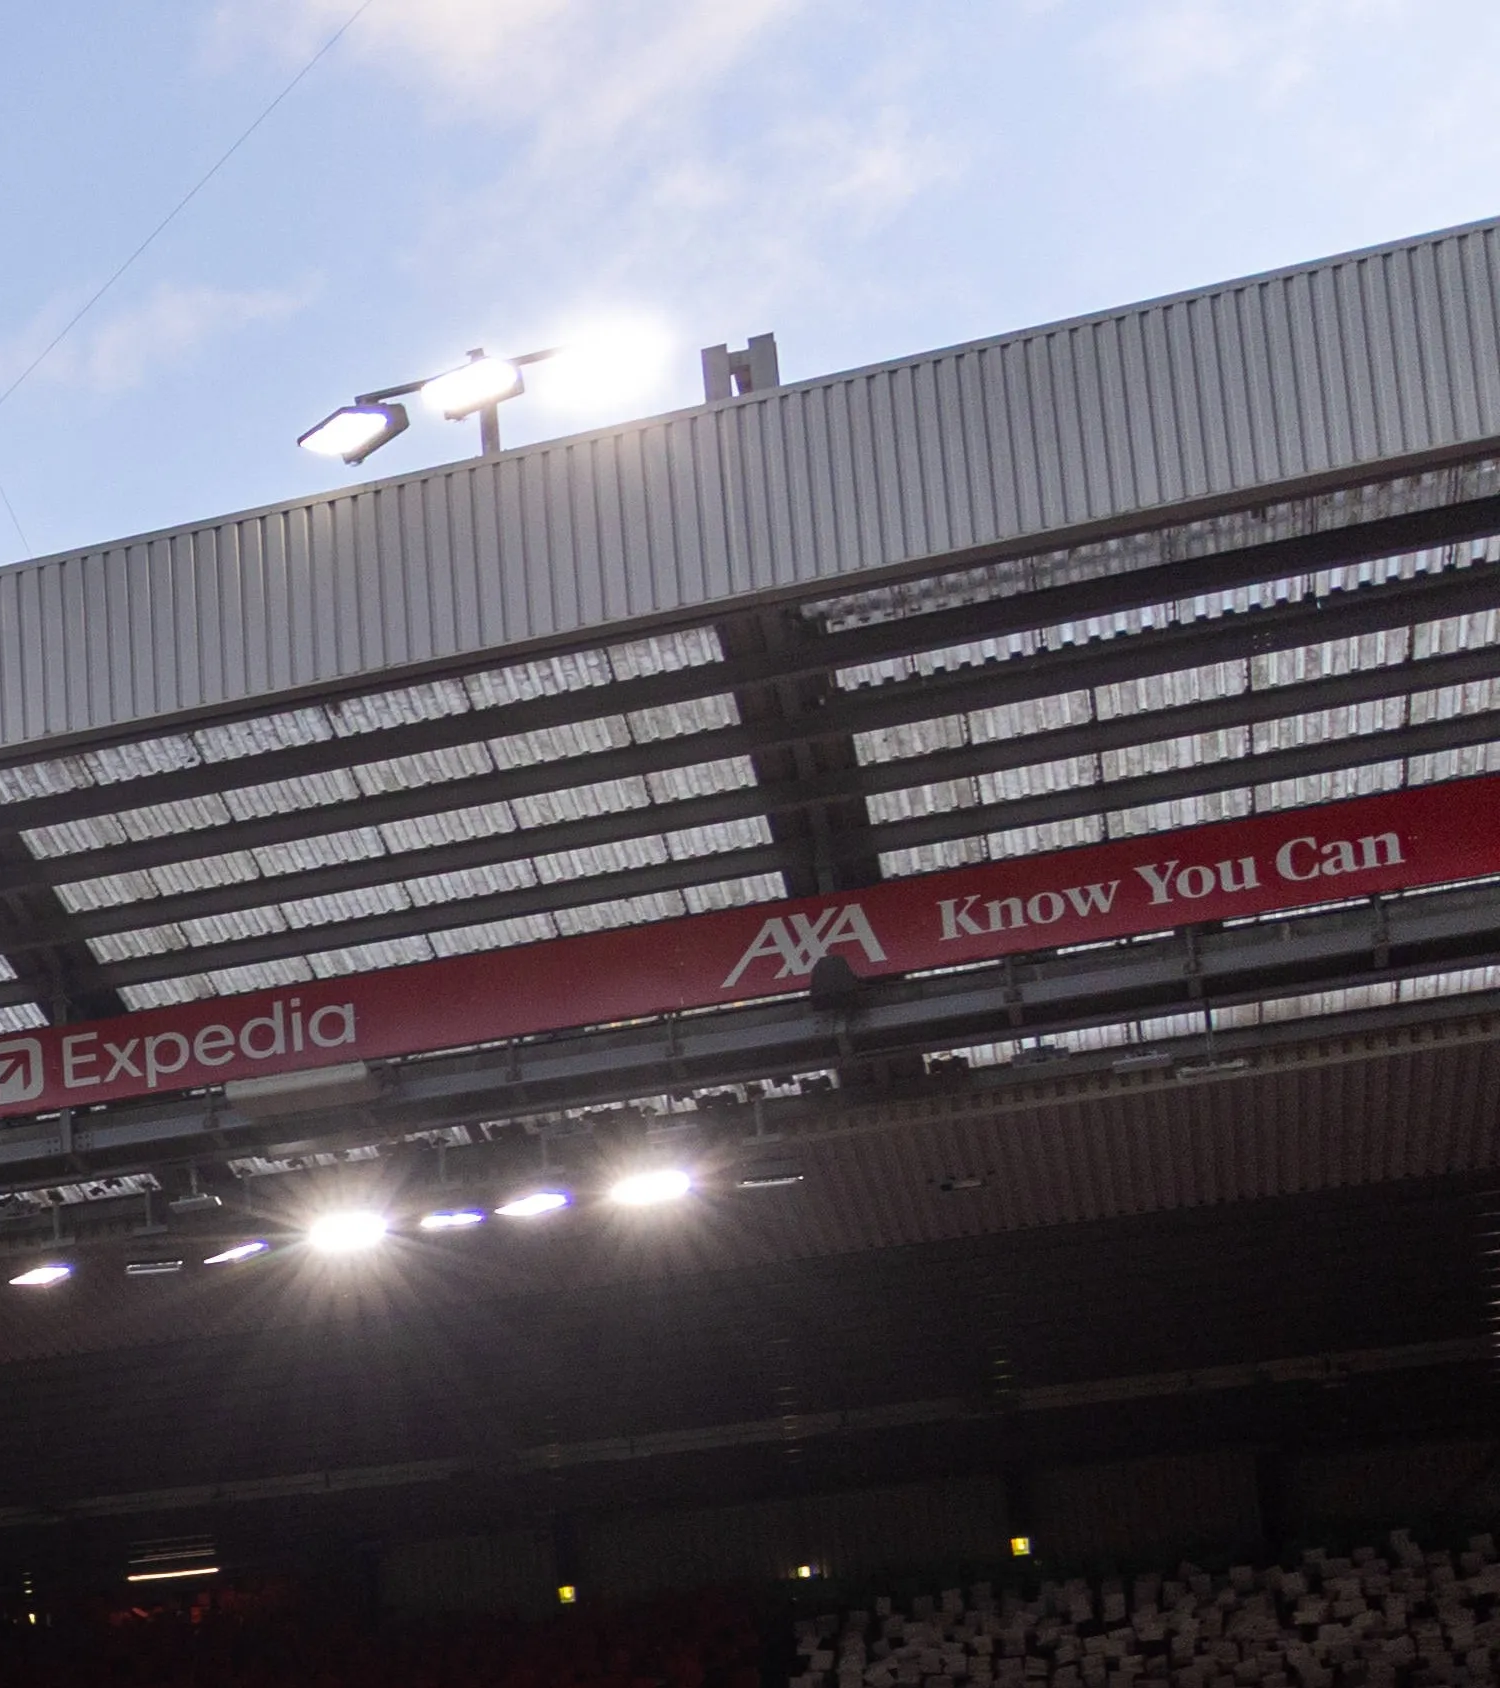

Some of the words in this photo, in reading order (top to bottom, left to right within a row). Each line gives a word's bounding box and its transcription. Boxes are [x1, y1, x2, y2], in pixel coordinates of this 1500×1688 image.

[936, 880, 1121, 942] Know
[1133, 850, 1260, 907] You
[1273, 829, 1406, 882] Can
[720, 903, 887, 989] AXA
[62, 997, 357, 1089] Expedia
